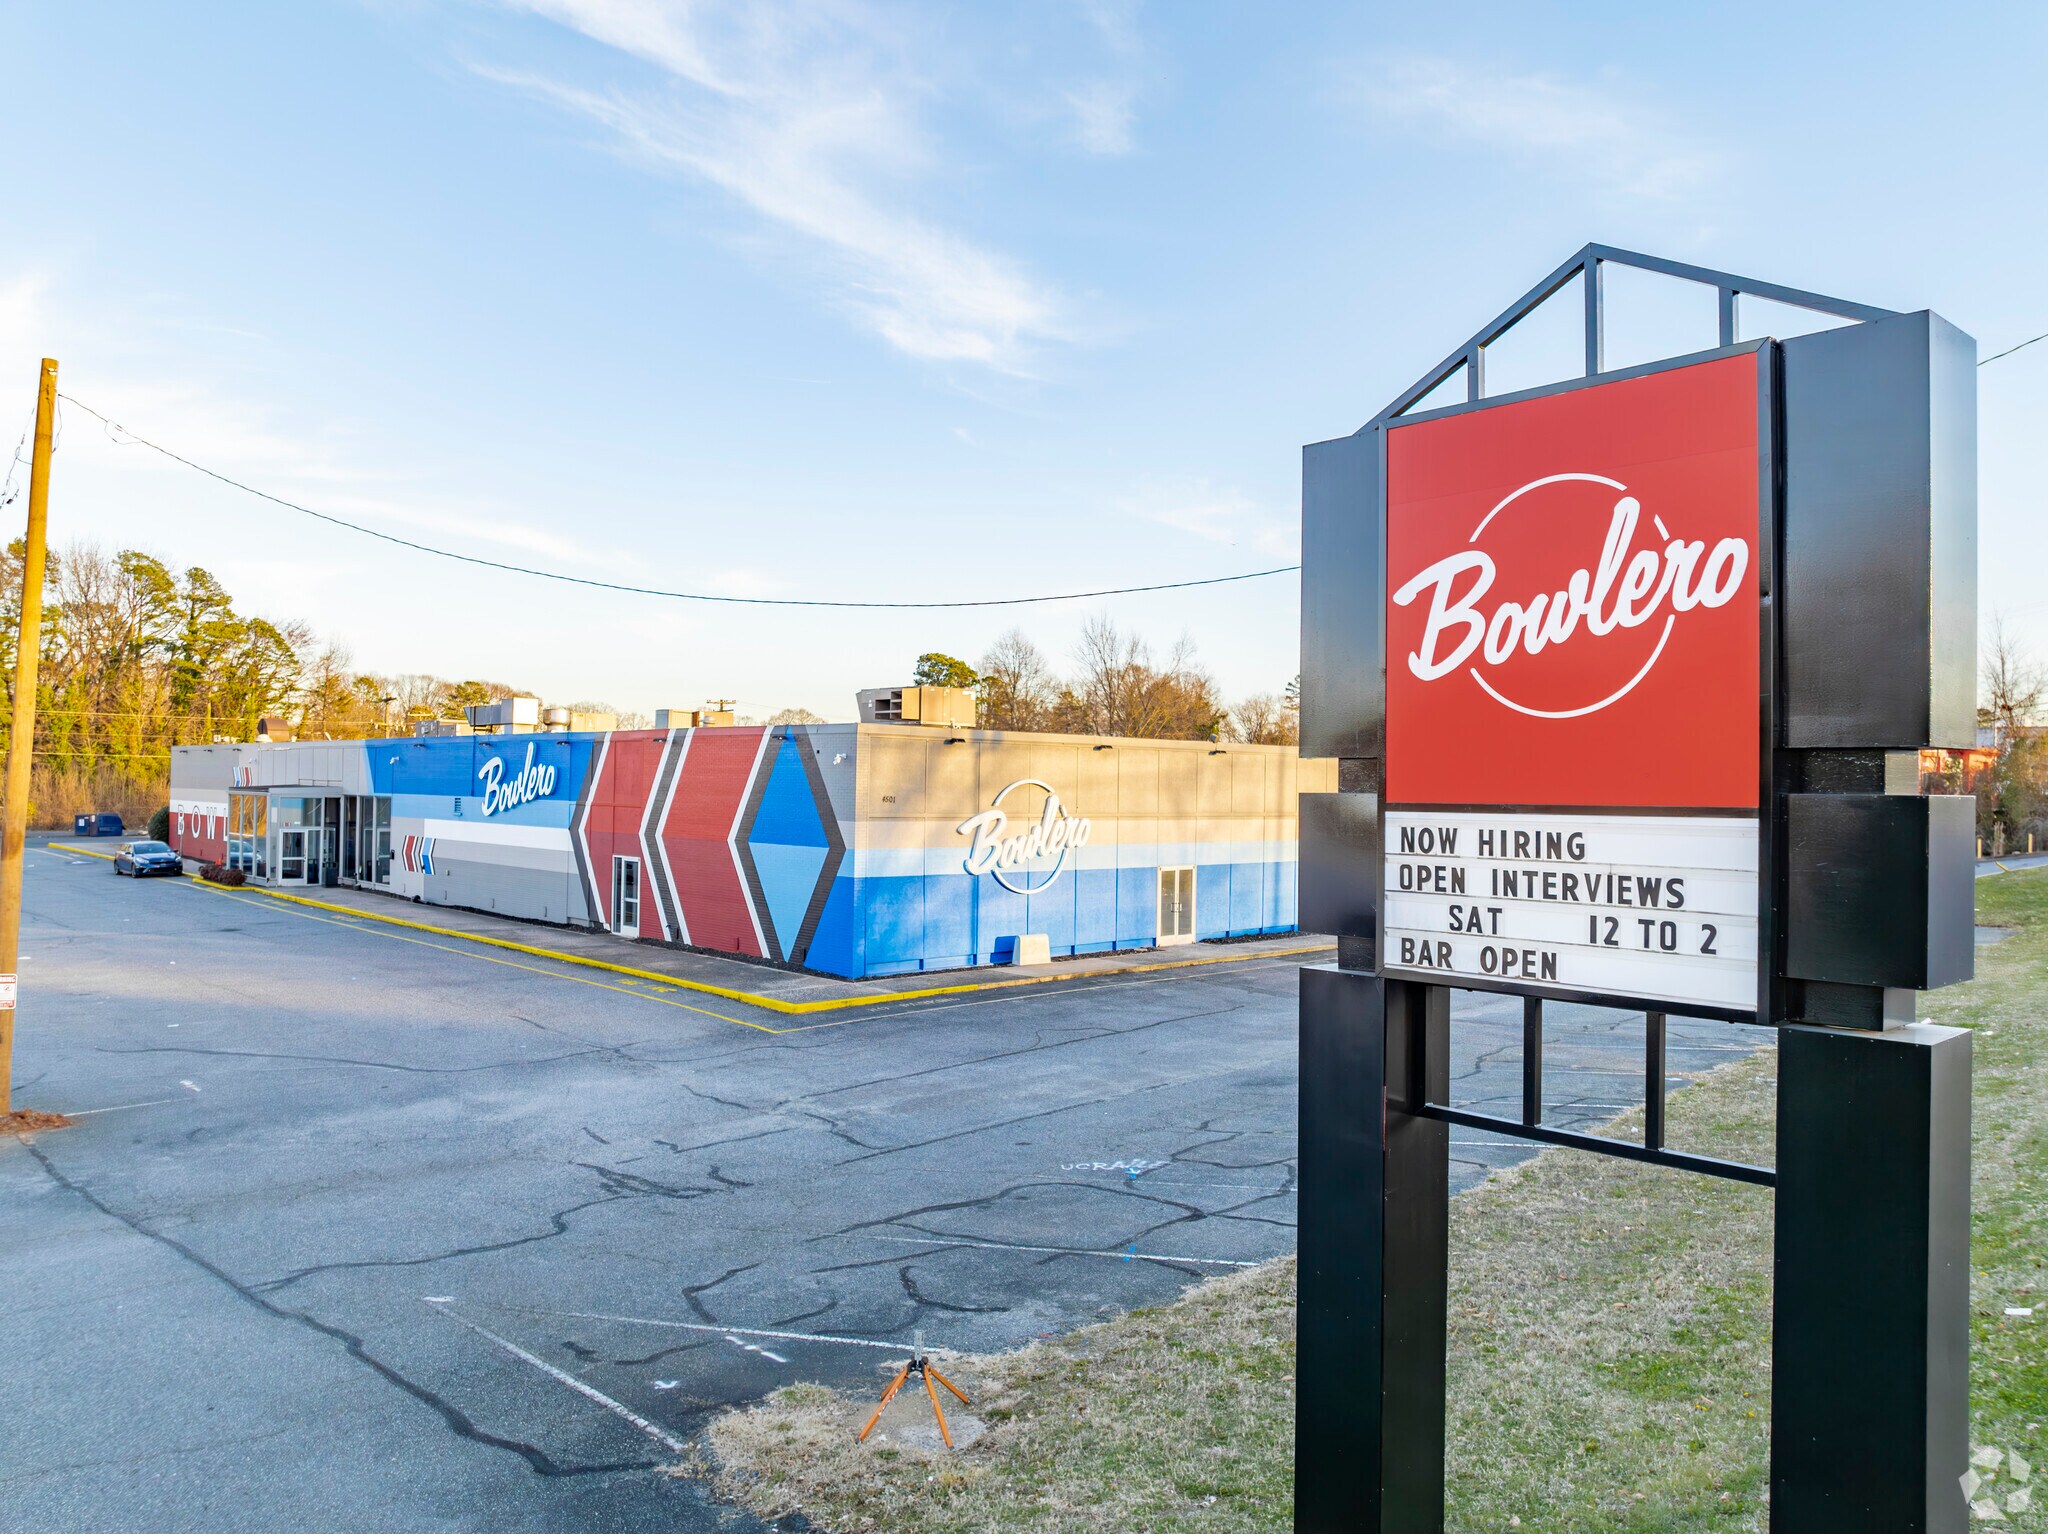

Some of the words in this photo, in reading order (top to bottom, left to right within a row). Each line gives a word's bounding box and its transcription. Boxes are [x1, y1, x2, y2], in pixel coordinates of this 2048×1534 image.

[478, 741, 556, 816] Bowlero
[956, 794, 1091, 876] Bowlero
[1400, 826, 1458, 855] NOW
[1478, 829, 1586, 861] HIRING
[1399, 864, 1466, 894] OPEN
[1492, 868, 1685, 909] INTERVIEWS
[1449, 904, 1503, 935] SAT
[1589, 915, 1619, 945] 12
[1638, 918, 1676, 951] TO
[1700, 923, 1718, 955] 2
[1400, 937, 1453, 969] BAR
[1480, 945, 1557, 980] OPEN
